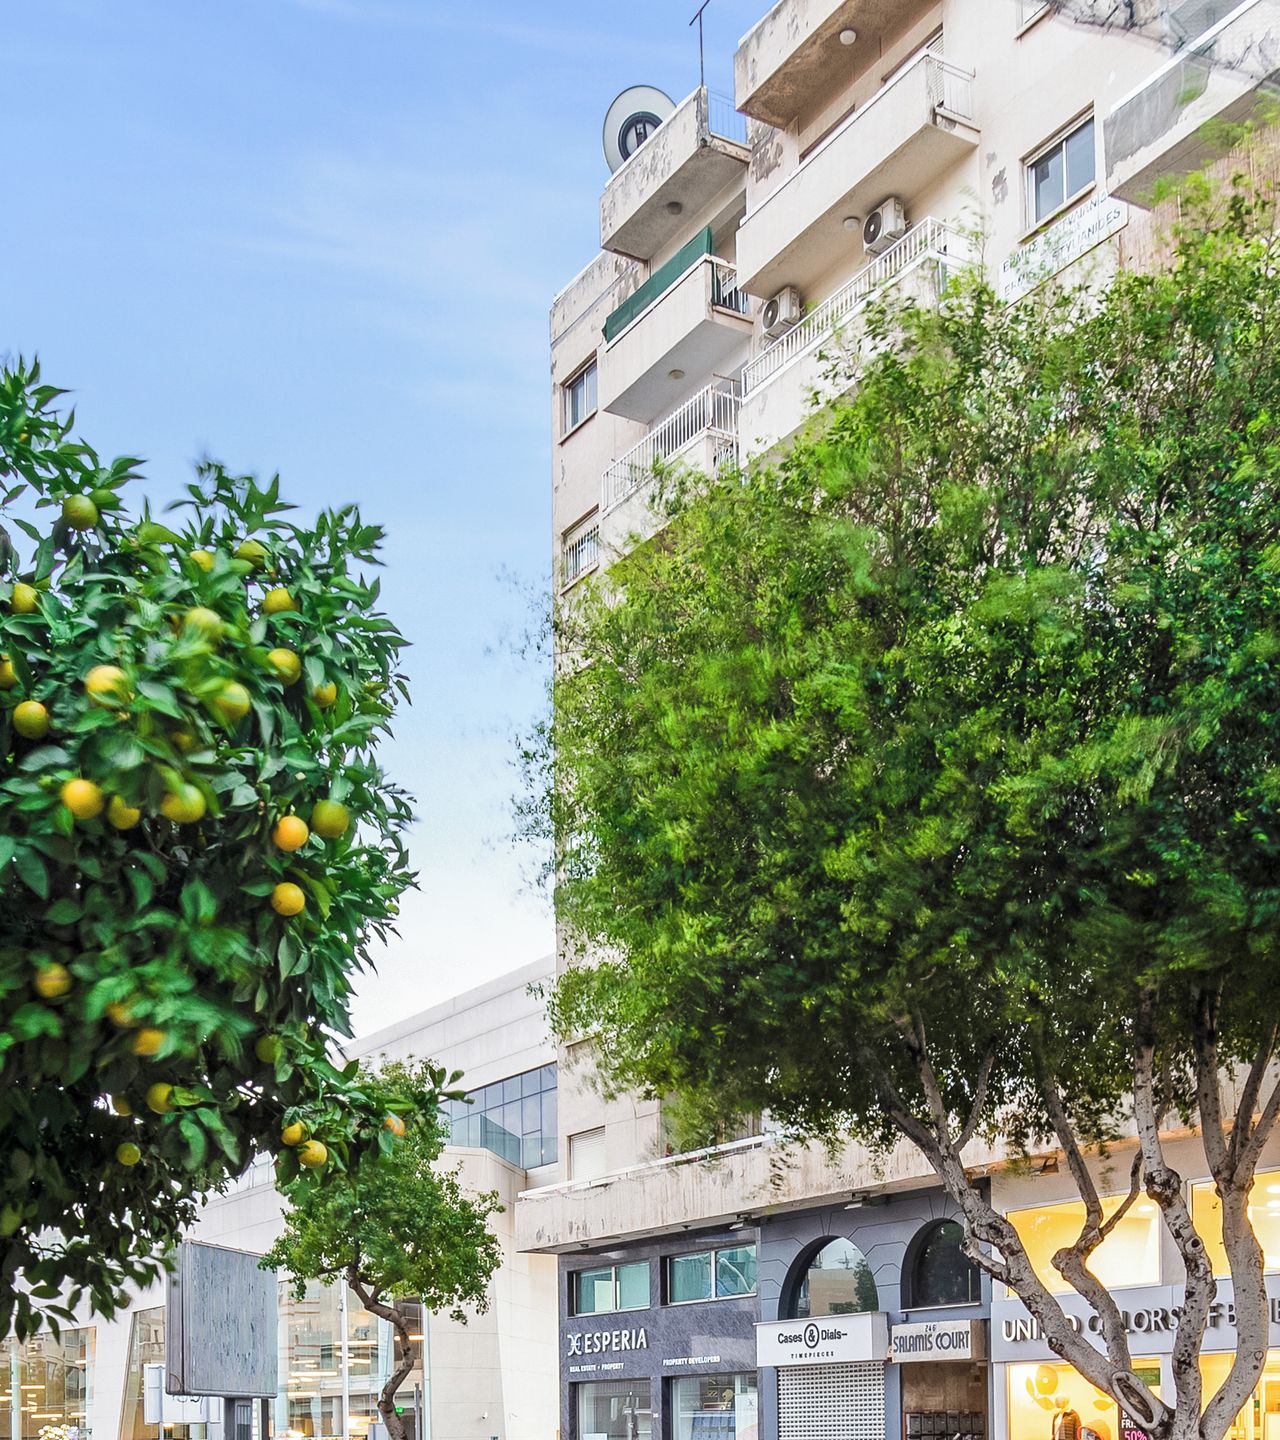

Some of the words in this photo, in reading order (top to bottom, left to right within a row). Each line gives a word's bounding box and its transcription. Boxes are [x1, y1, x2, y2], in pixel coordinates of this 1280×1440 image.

[584, 1327, 648, 1354] ESPERIA
[777, 1333, 803, 1344] Cases
[893, 1333, 934, 1353] SALAMIS
[935, 1330, 970, 1351] COURT
[662, 1358, 688, 1366] PROPERTY
[688, 1355, 720, 1365] DEVELOPERS
[790, 1351, 834, 1359] TIMEPIECES
[569, 1365, 580, 1373] REAL
[580, 1364, 596, 1372] ESTATE
[601, 1362, 624, 1371] PROPERTY
